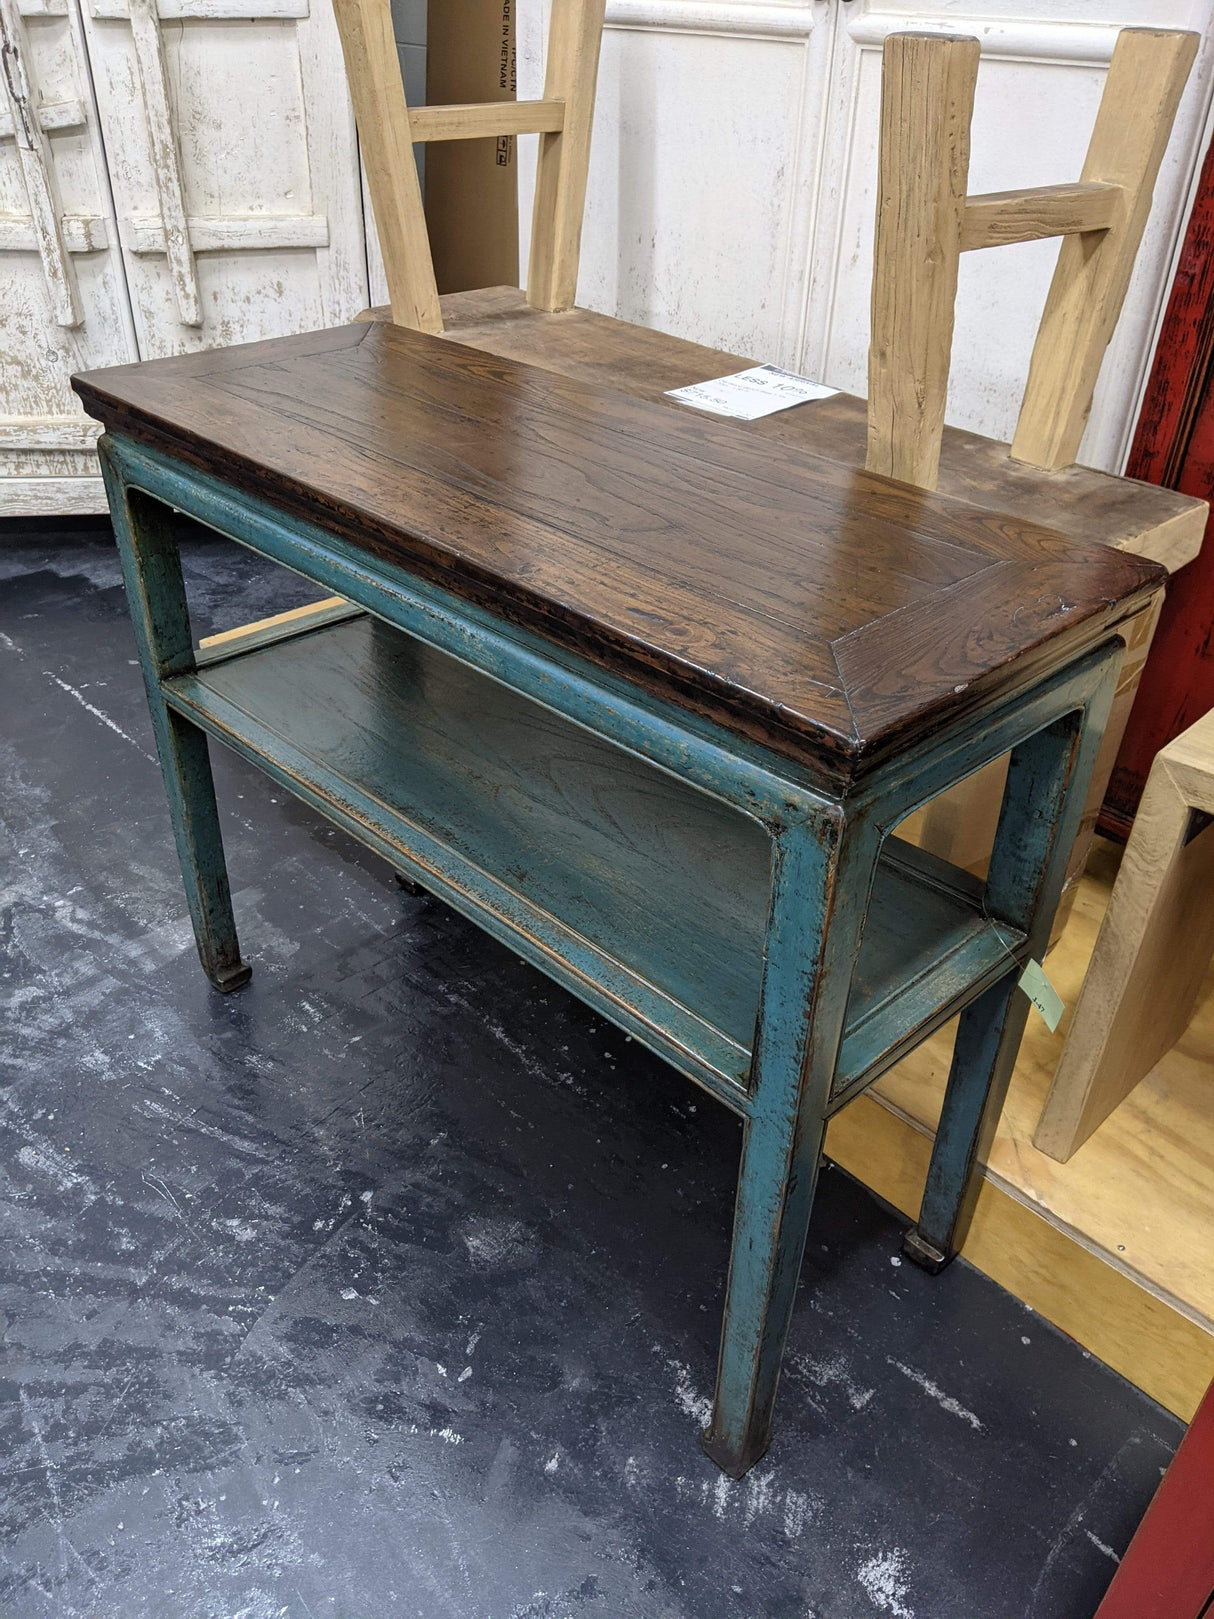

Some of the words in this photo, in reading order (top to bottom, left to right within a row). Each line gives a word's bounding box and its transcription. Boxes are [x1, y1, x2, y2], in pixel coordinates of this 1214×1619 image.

[502, 0, 510, 22] ADE
[502, 24, 509, 36] IN
[499, 39, 509, 88] VIETNAM
[734, 374, 769, 386] LESS
[772, 384, 808, 395] 10%
